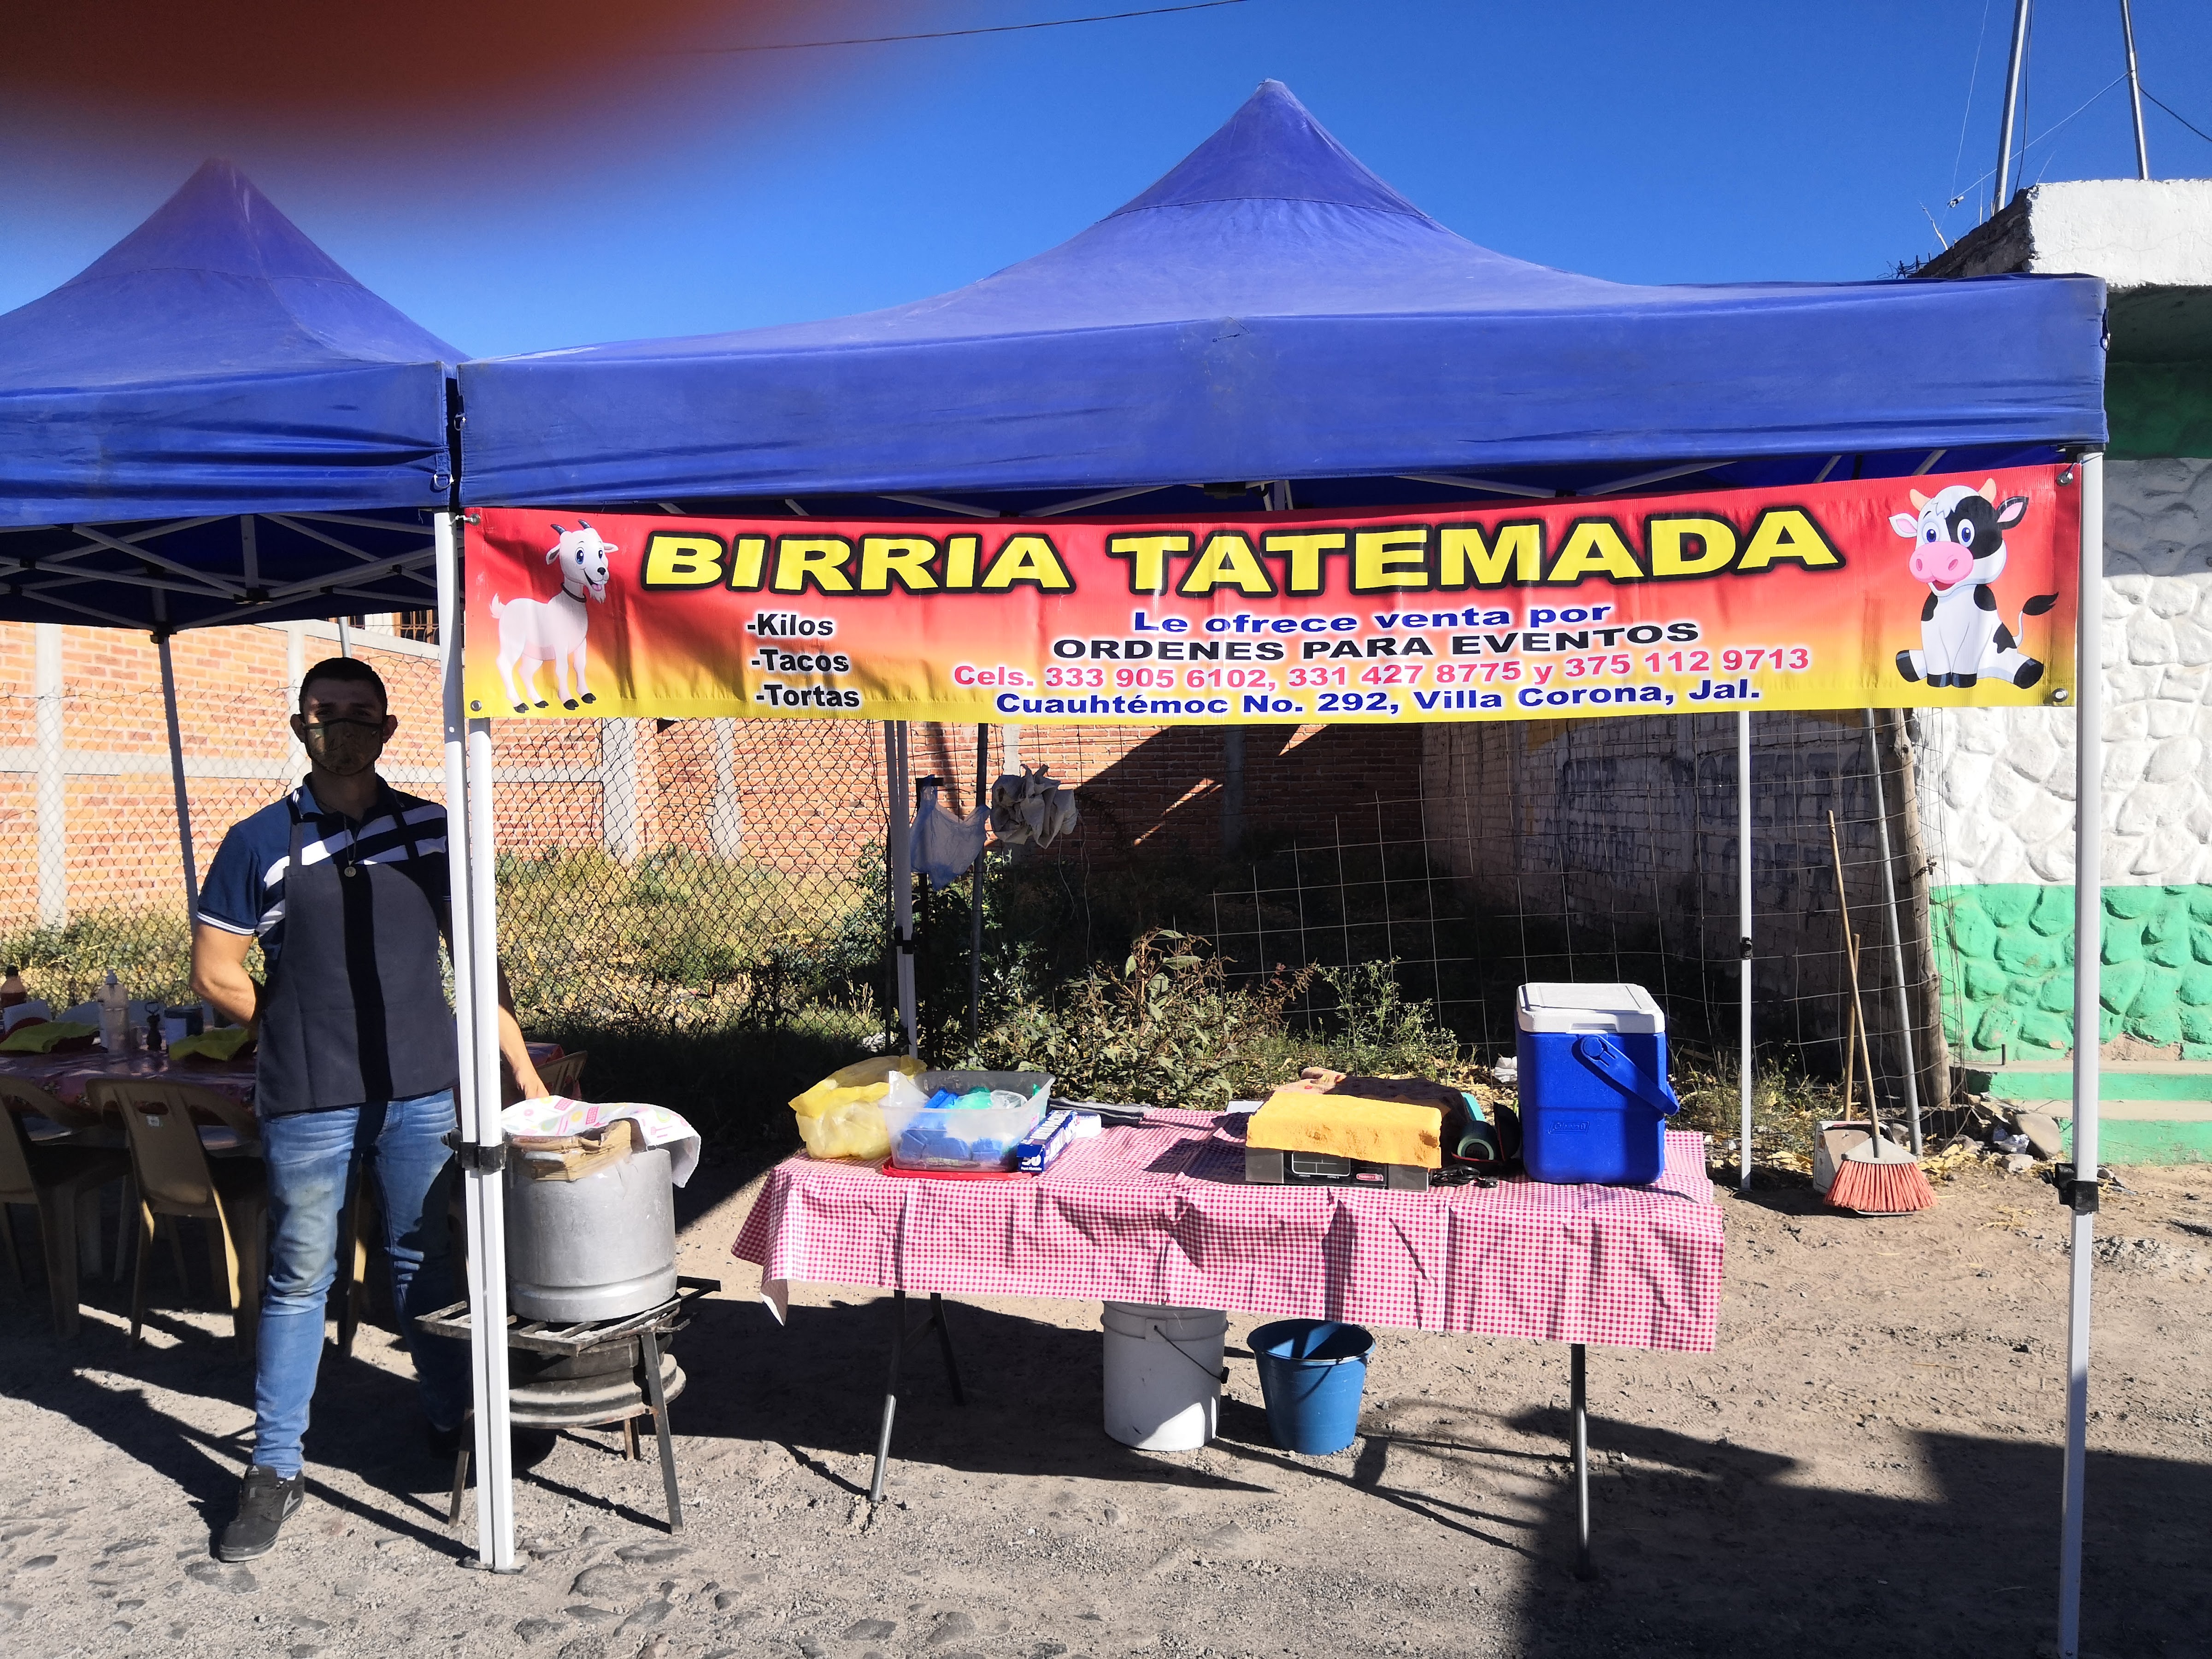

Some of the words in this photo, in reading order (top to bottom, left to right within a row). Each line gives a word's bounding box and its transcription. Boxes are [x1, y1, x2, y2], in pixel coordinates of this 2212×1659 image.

[641, 531, 1076, 596] BIRRIA
[1106, 506, 1845, 597] TATEMADA
[747, 614, 834, 636] -Kilos
[1135, 612, 1188, 633] Le
[1206, 614, 1358, 633] ofrece
[1374, 608, 1509, 629] venta
[1530, 606, 1611, 628] por
[1053, 640, 1283, 660] ORDENES
[1303, 636, 1433, 659] PARA
[1452, 623, 1699, 655] EVENTOS
[752, 650, 850, 672] -Tacos
[954, 666, 1033, 686] Cels.
[1046, 667, 1104, 687] 333
[1116, 668, 1174, 688] 905
[1187, 668, 1275, 690] 6102,
[1288, 667, 1346, 687] 331
[1361, 665, 1421, 685] 427
[1436, 663, 1521, 683] 8775
[1534, 665, 1553, 685] y
[1565, 654, 1629, 677] 375
[1645, 651, 1709, 672] 112
[1724, 648, 1809, 671] 9713
[757, 685, 860, 707] -Tortas
[996, 693, 1228, 714] Cuauhtémoc
[1243, 694, 1303, 712] No.
[1318, 692, 1398, 715] 292,
[1414, 689, 1502, 709] Villa
[1519, 685, 1673, 706] Corona,
[1689, 679, 1759, 701] Jal.
